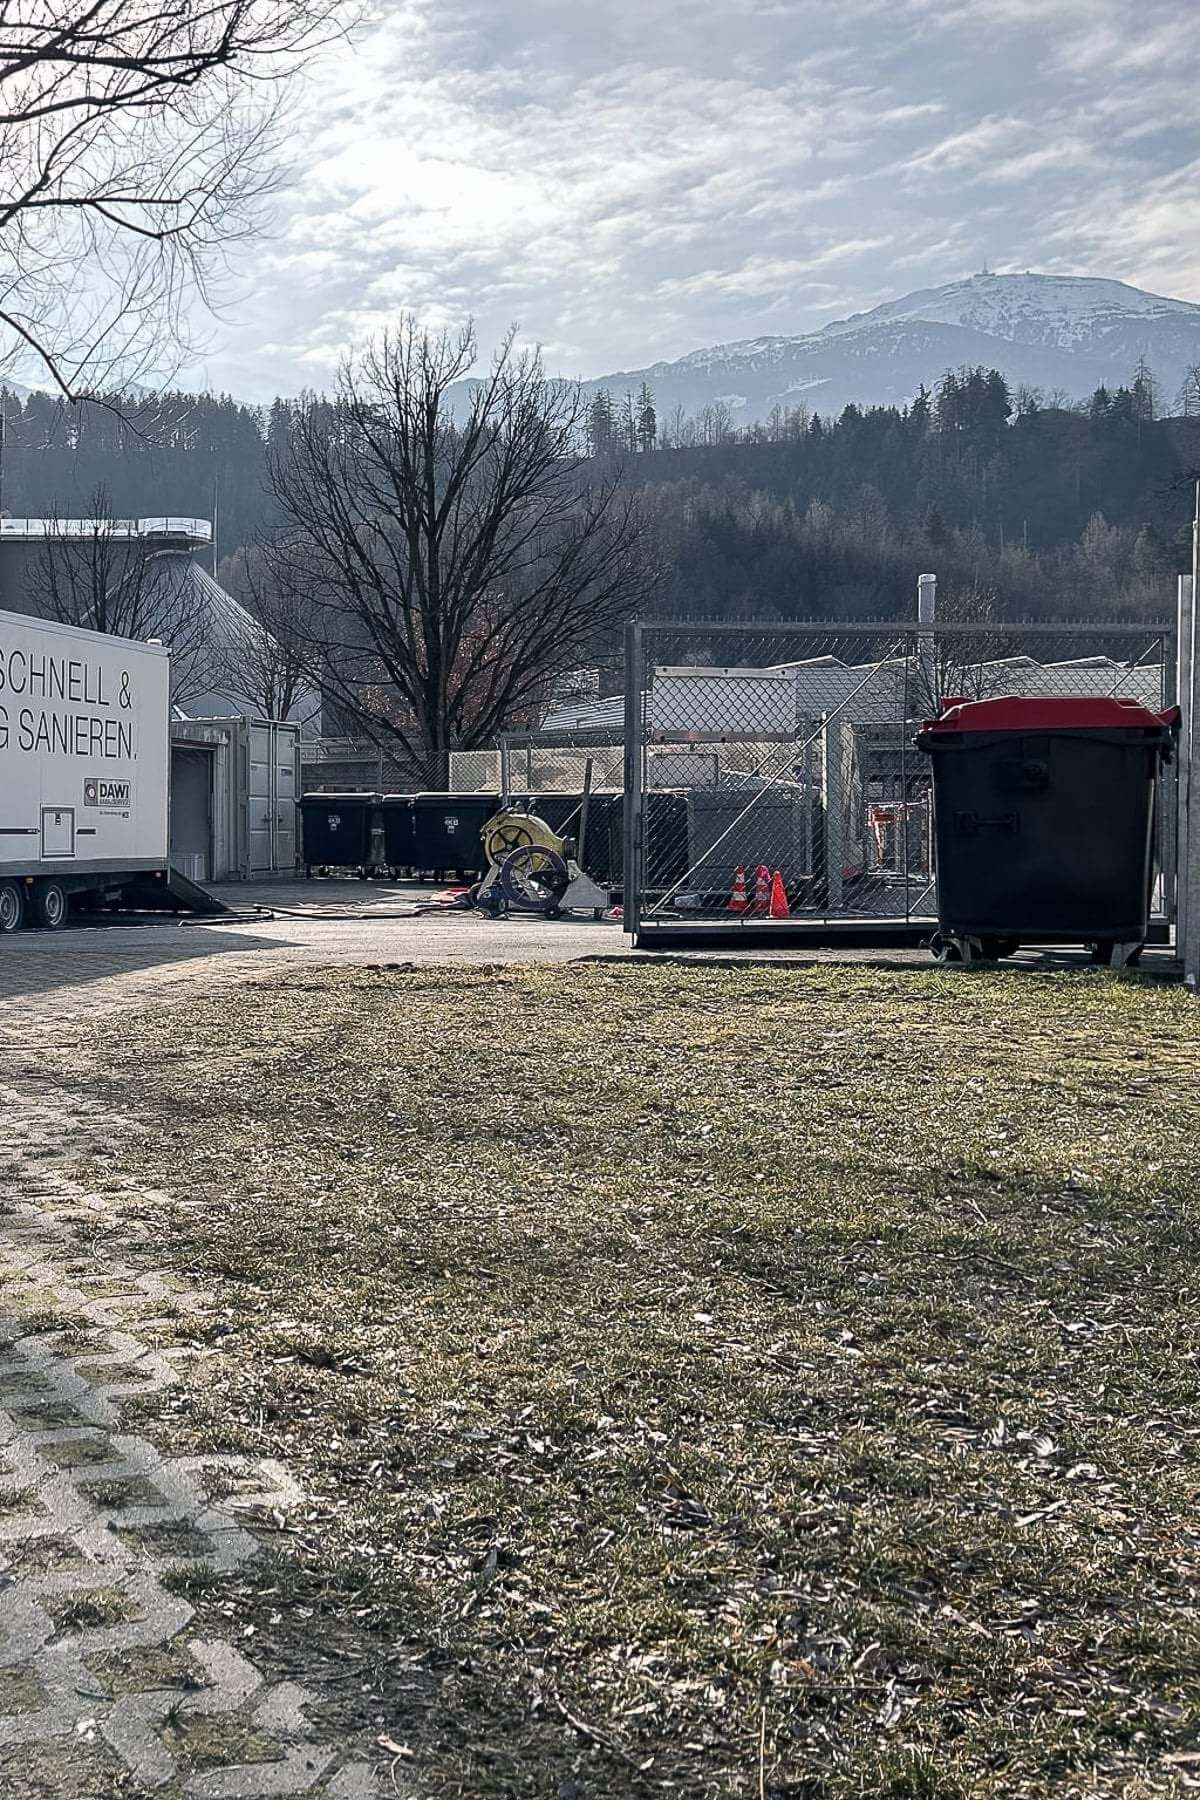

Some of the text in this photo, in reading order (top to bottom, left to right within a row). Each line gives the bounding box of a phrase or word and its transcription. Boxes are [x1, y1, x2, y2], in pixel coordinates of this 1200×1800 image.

[119, 671, 132, 709] &
[18, 708, 137, 760] SANIEREN.
[99, 783, 129, 799] DAWI
